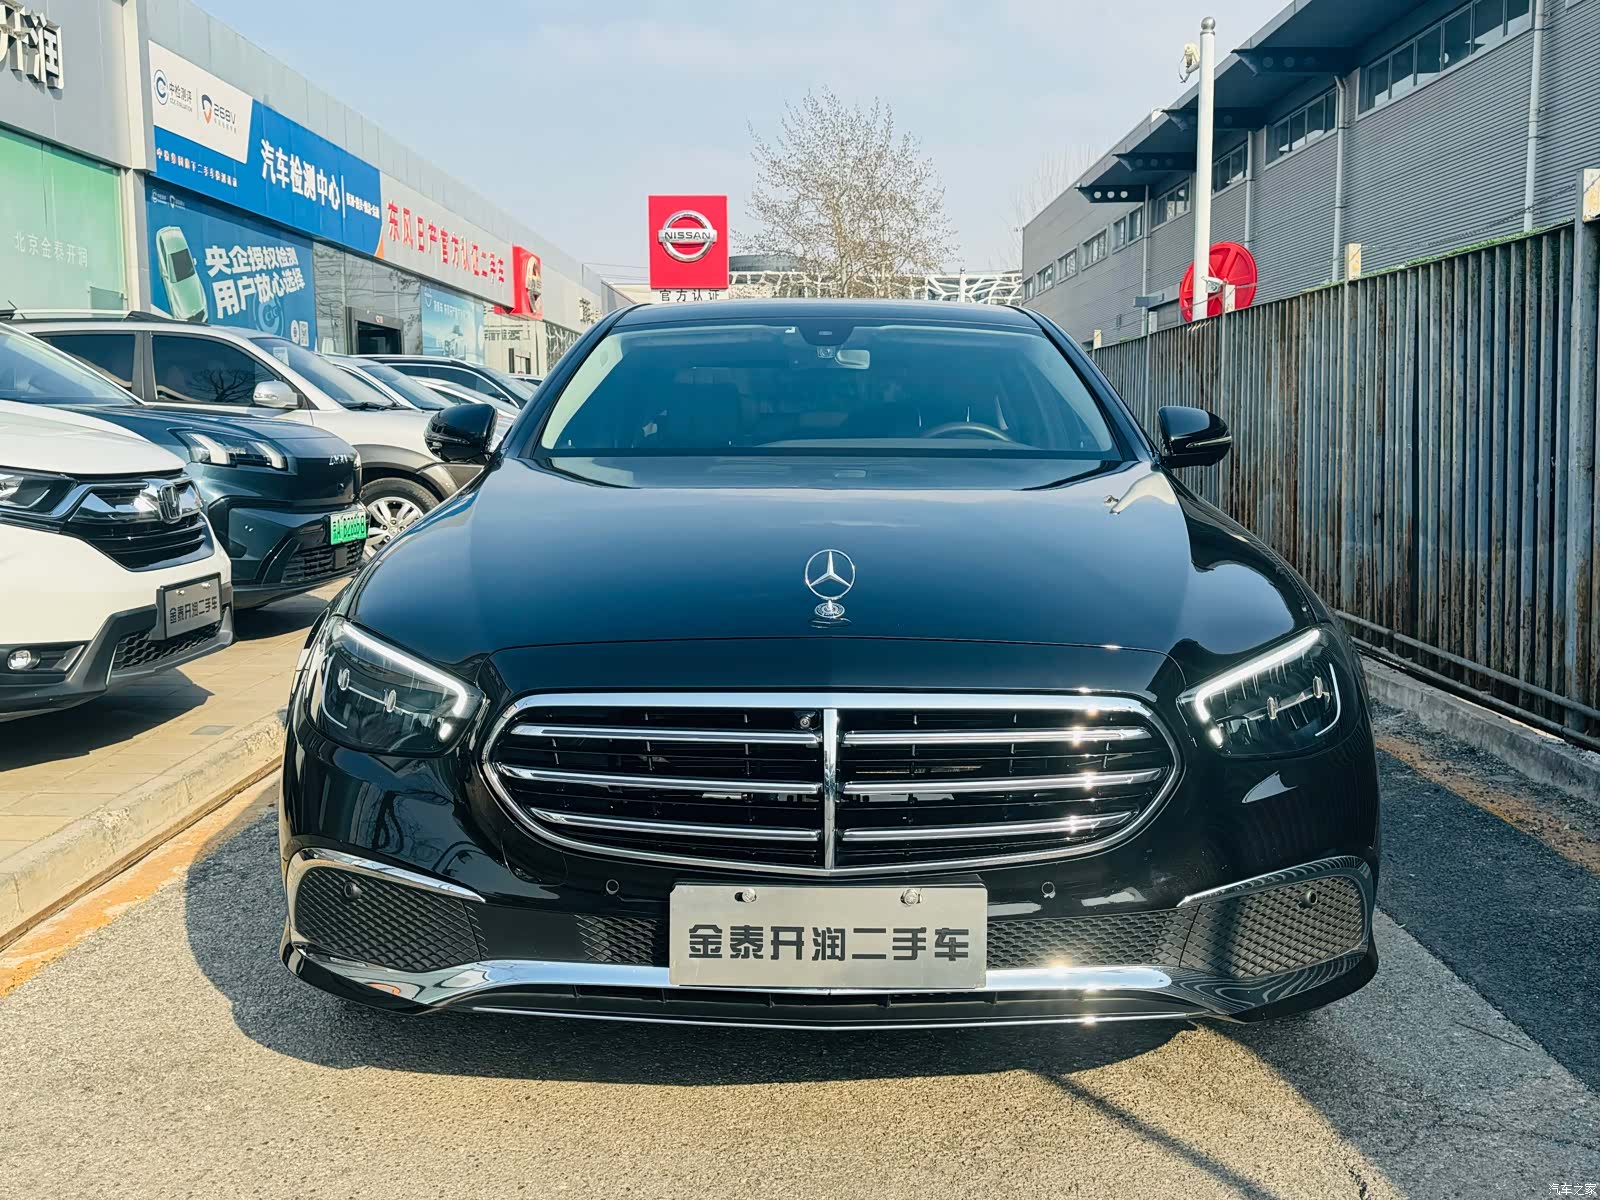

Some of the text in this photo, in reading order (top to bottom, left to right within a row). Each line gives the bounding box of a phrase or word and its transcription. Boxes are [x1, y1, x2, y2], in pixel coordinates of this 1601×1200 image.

[261, 139, 341, 211] 汽车检测中心
[387, 199, 505, 287] 东风日产官方认证二手车
[664, 231, 711, 240] NISSAN
[205, 245, 299, 278] 央企授权检测
[212, 268, 305, 319] 用户放心选择
[659, 289, 720, 302] 官方认证
[170, 596, 217, 624] 金泰开润二手车
[689, 924, 969, 961] 金泰开润二手车
